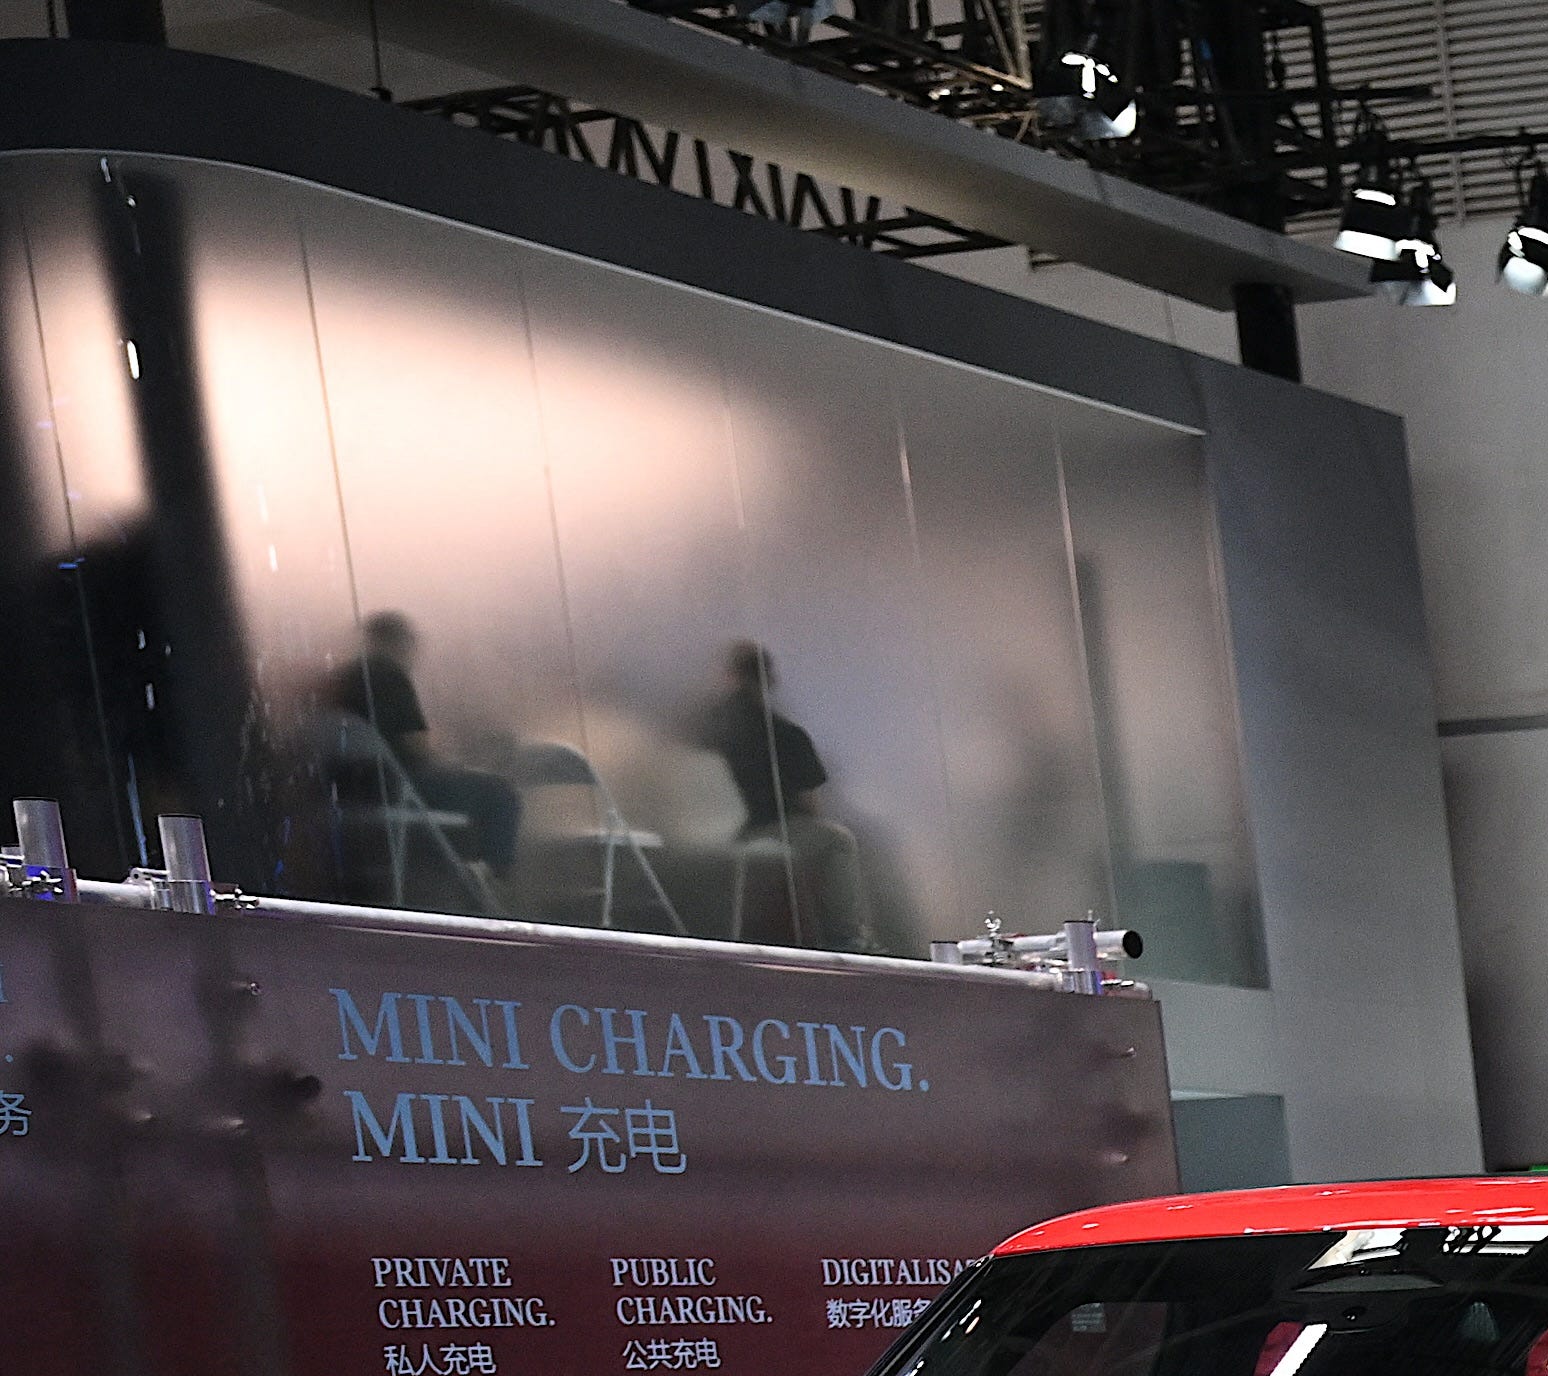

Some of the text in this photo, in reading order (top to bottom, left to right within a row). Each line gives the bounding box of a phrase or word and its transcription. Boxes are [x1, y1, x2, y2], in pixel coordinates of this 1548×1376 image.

[328, 988, 930, 1093] MINI CHARGING.
[343, 1090, 688, 1175] MINI 充电
[371, 1257, 512, 1289] PRIVATE
[610, 1257, 717, 1287] PUBLIC
[378, 1298, 556, 1330] CHARGING.
[616, 1295, 774, 1326] CHARGING.
[621, 1337, 722, 1371] 公共充电
